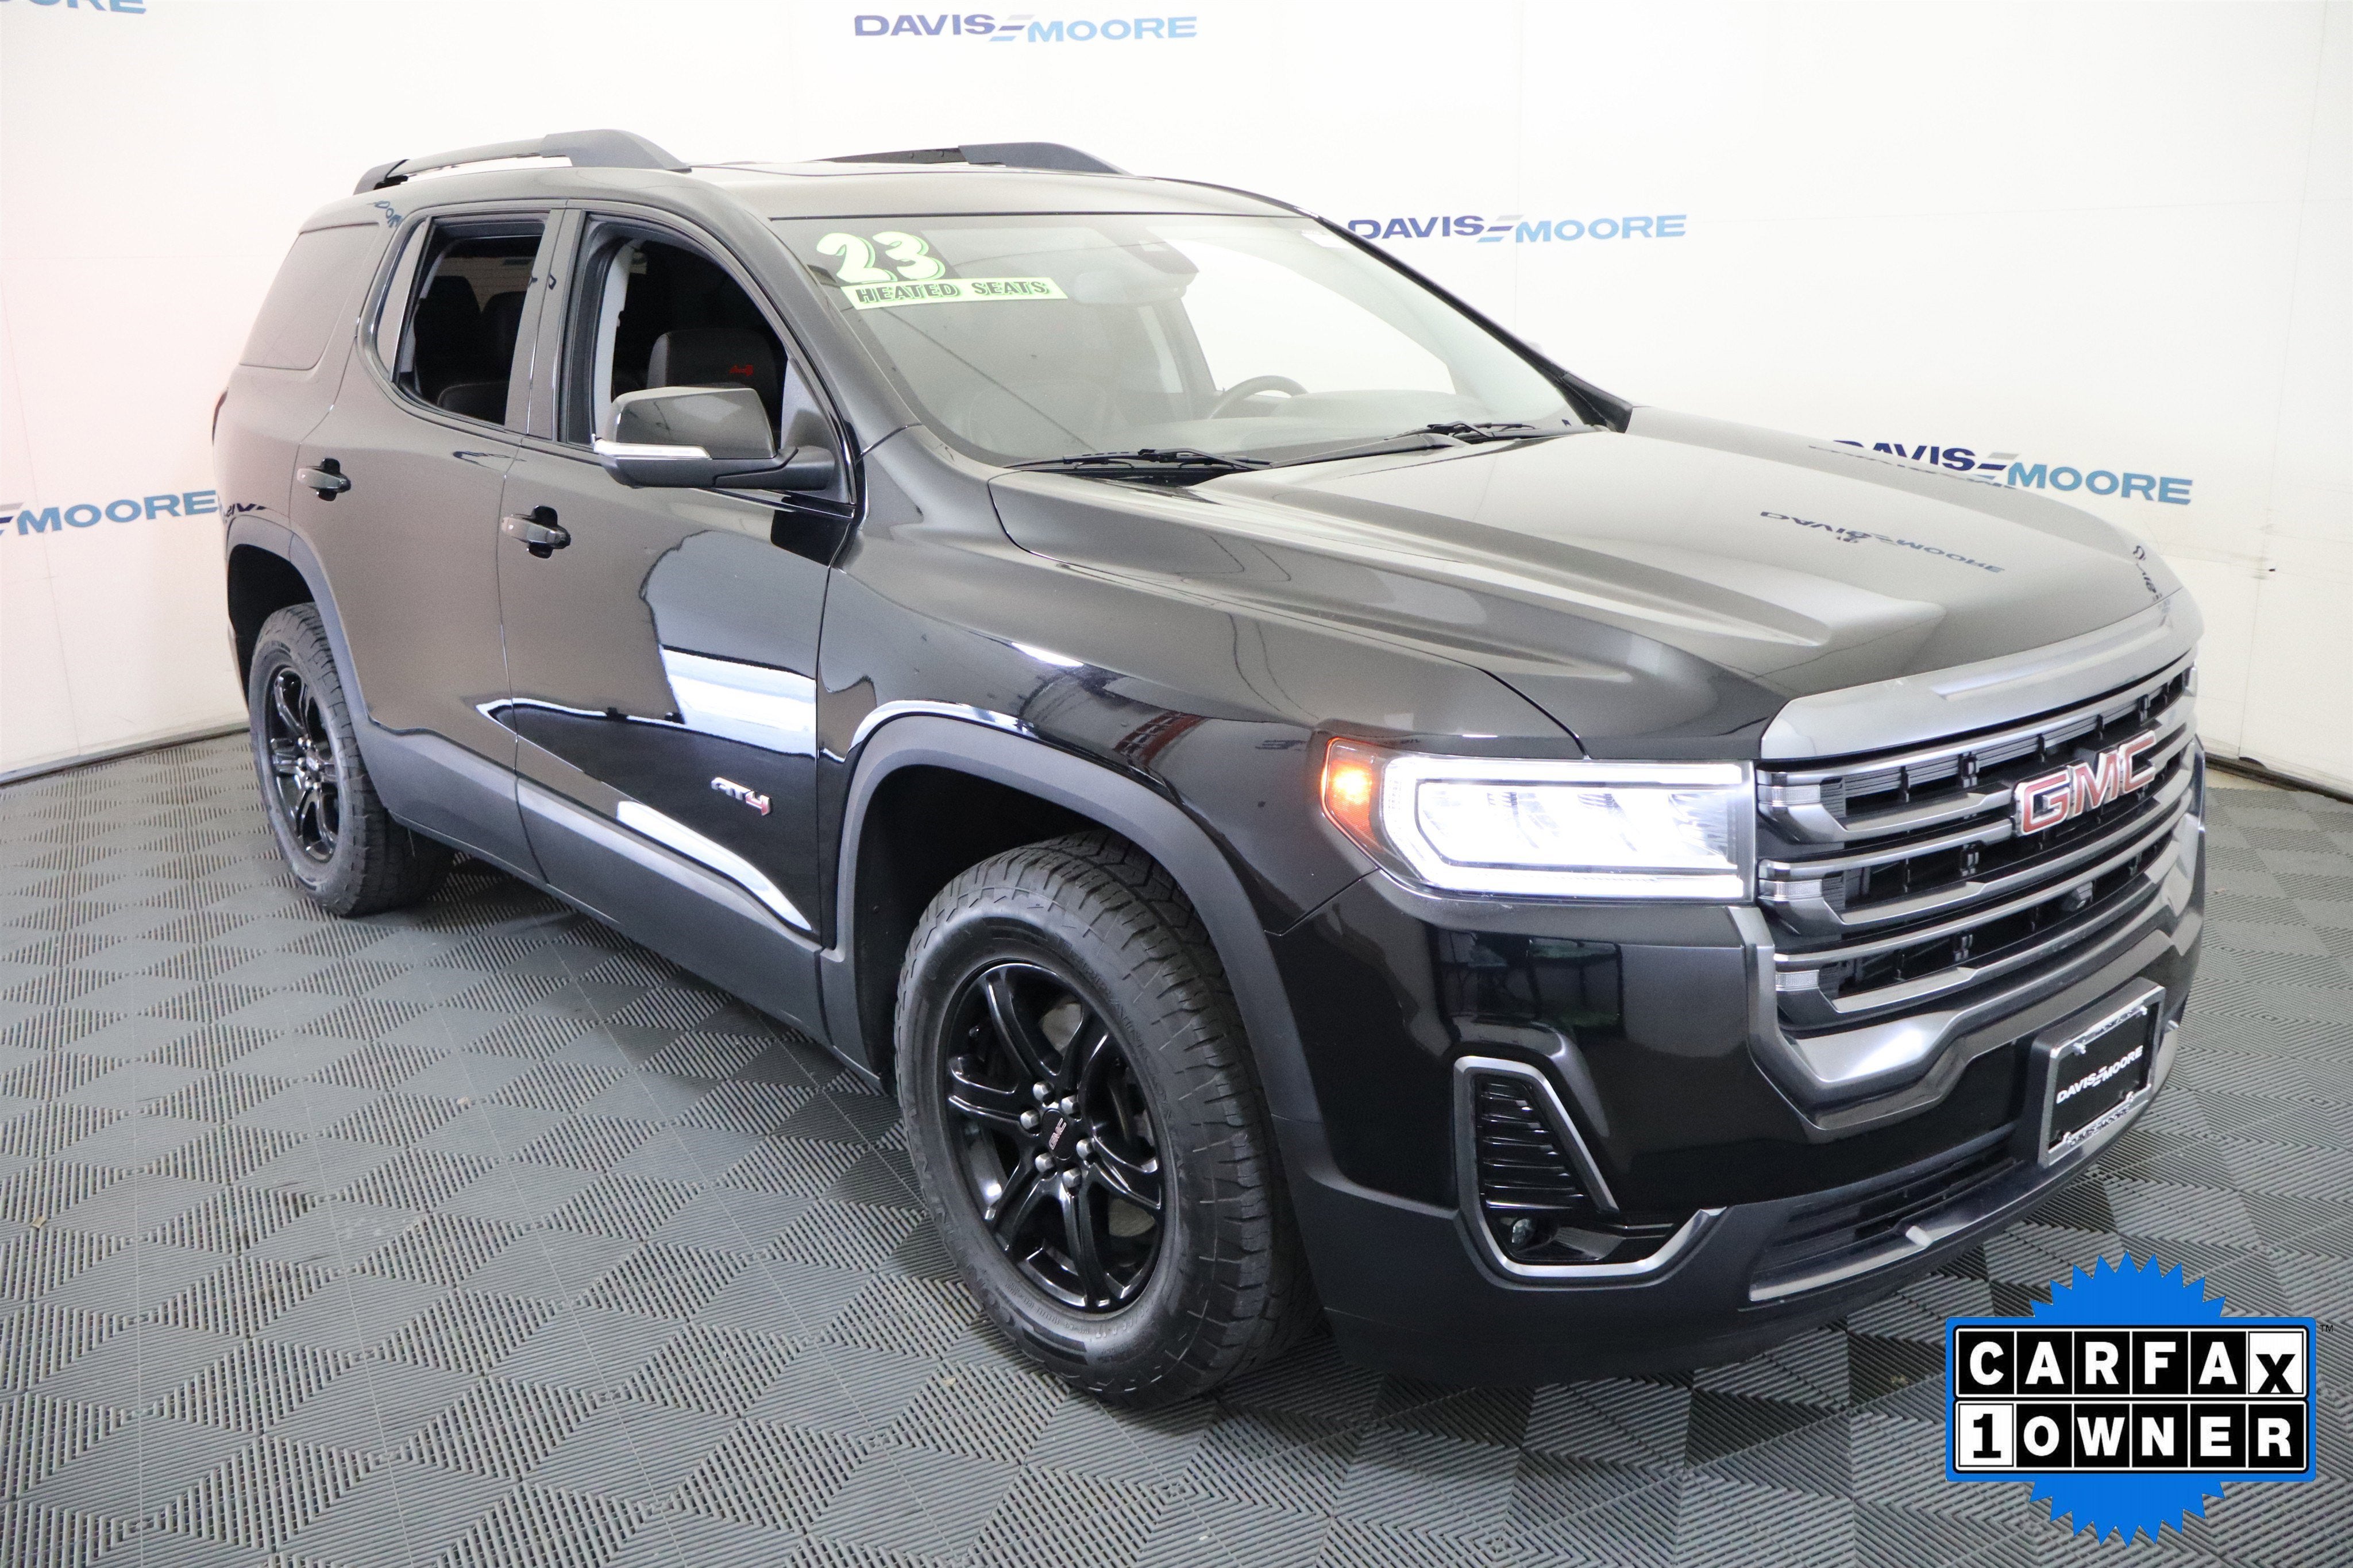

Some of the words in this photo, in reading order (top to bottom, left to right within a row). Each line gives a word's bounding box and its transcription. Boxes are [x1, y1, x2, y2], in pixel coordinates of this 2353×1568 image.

[854, 14, 996, 36] DAVIS
[1027, 16, 1198, 43] MOORE
[1348, 215, 1486, 239] DAVIS
[1515, 214, 1687, 243] MOORE
[816, 231, 946, 284] 23
[855, 282, 961, 303] HEATED
[971, 280, 1051, 296] SEATS
[1833, 440, 1976, 471] VIS
[2008, 462, 2193, 505] MOORE
[17, 489, 219, 535] MOORE
[2014, 730, 2157, 835] GMC
[2056, 1073, 2097, 1104] DAVIS
[2102, 1045, 2143, 1082] MOORE
